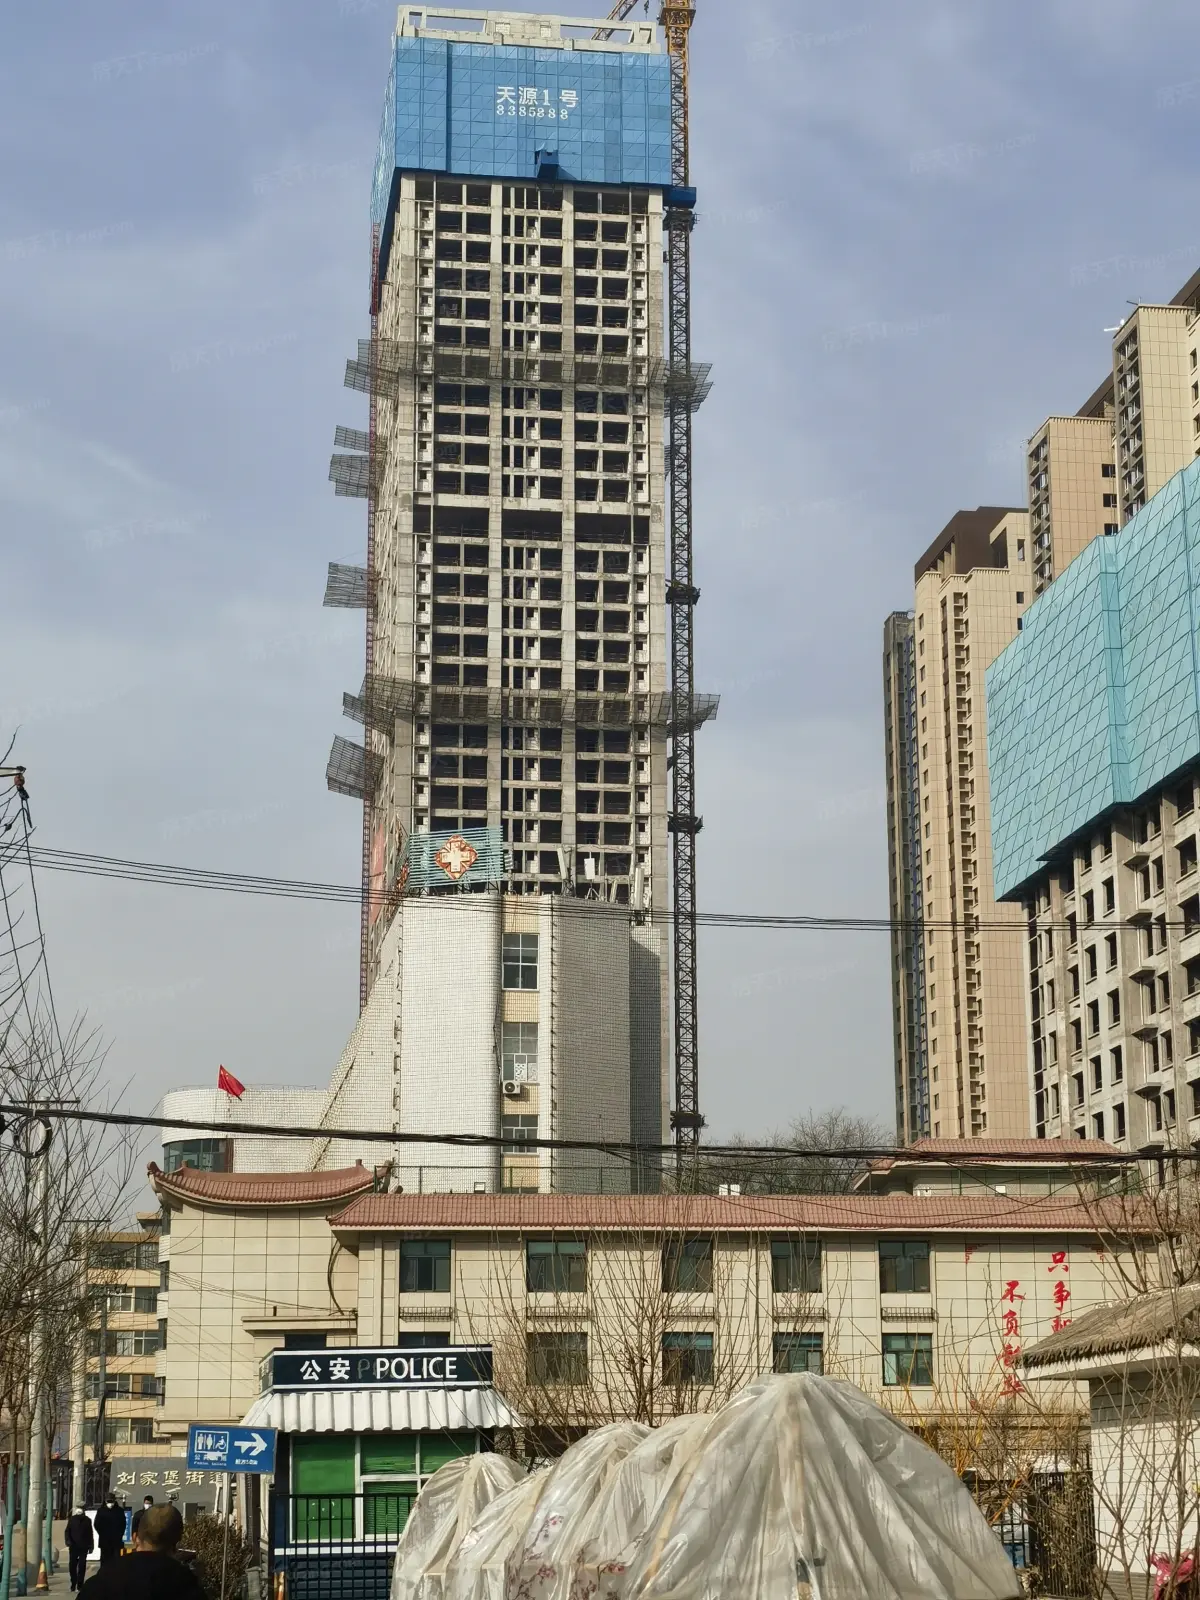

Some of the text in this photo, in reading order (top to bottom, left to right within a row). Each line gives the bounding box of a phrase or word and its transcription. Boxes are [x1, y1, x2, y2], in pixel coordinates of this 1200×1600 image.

[496, 86, 579, 108] 天源1号
[496, 104, 569, 120] 8385888
[299, 1357, 351, 1381] 公安
[376, 1356, 458, 1380] POLICE
